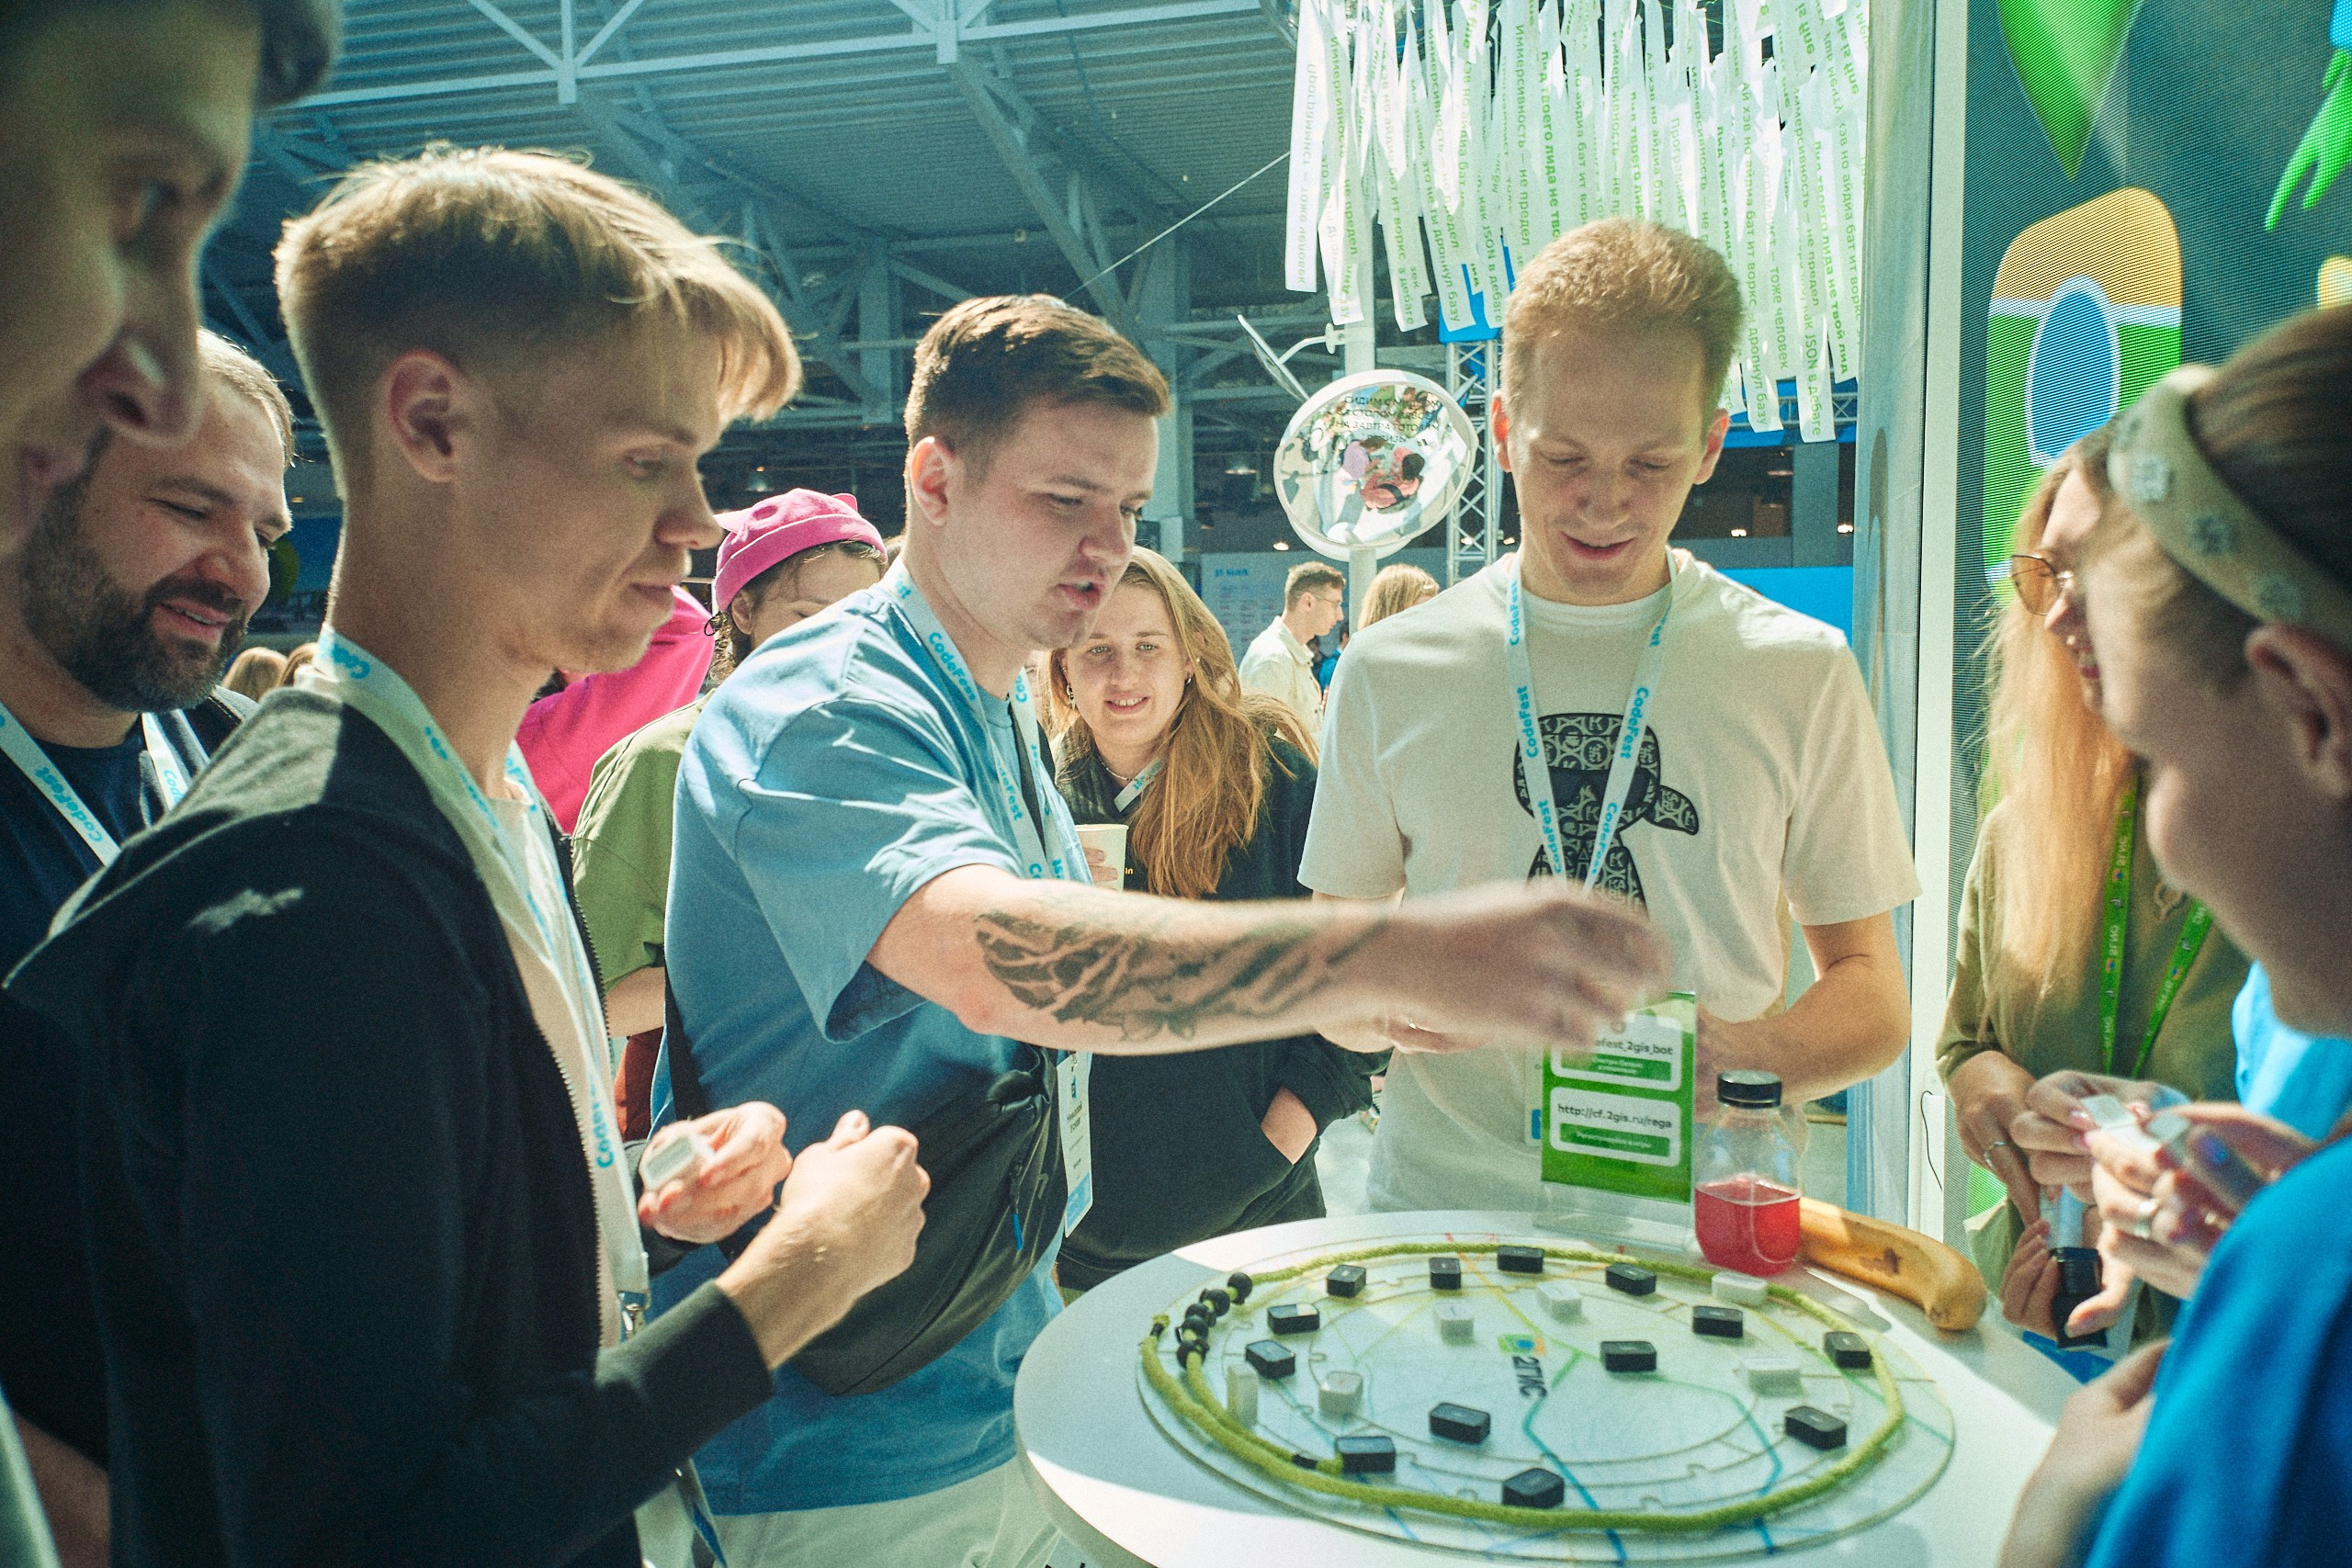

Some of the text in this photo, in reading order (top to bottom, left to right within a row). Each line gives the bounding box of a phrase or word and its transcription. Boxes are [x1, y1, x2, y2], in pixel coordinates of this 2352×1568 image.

[1515, 24, 1527, 149] Иммерсивность
[1647, 75, 1657, 102] хэв
[1540, 86, 1555, 141] твоего
[1575, 92, 1585, 138] айдиа
[1650, 105, 1658, 125] но
[1544, 144, 1558, 185] лида
[1577, 141, 1589, 168] бат
[1652, 129, 1663, 175] айдиа
[1690, 66, 1710, 230] Иммерсивность не
[1840, 150, 1850, 169] но
[1458, 161, 1470, 186] бат
[1520, 169, 1529, 187] не
[1579, 172, 1587, 190] ит
[1611, 177, 1620, 196] не
[1653, 178, 1665, 205] бат
[1716, 126, 1736, 260] Лид твоего лида
[1741, 82, 1758, 306] Ай хэв но айдиа бат ит воркс
[1391, 196, 1400, 212] ит
[1548, 188, 1559, 208] не
[1842, 174, 1855, 220] айдиа
[1342, 200, 1359, 255] предел
[1393, 217, 1407, 260] воркс
[1519, 191, 1532, 246] предел
[1806, 228, 1816, 248] не
[1845, 224, 1858, 250] бат
[1426, 186, 1435, 204] не
[1433, 228, 1453, 288] дропнул
[1446, 290, 1461, 322] базу
[1483, 224, 1498, 260] JSON
[1821, 235, 1835, 276] лида
[1805, 251, 1820, 306] предел
[1848, 254, 1858, 272] ит
[1398, 276, 1416, 325] дебаге
[1770, 265, 1784, 304] тоже
[1826, 279, 1838, 299] не
[1774, 307, 1790, 369] человек
[1830, 300, 1846, 340] твой
[1804, 333, 1819, 370] JSON
[1838, 343, 1849, 374] лид
[1747, 327, 1765, 389] дропнул
[1756, 392, 1769, 425] базу
[1808, 374, 1816, 382] в
[1806, 387, 1823, 435] дебаге
[928, 632, 977, 703] CodeFest
[1516, 685, 1539, 758] CodeFest
[1620, 687, 1649, 760] CodeFest
[35, 766, 103, 843] CodeFest
[1538, 799, 1562, 874] CodeFest
[1591, 802, 1617, 874] CodeFest
[1595, 1038, 1674, 1055] efest_2gis_bot
[1557, 1103, 1673, 1130] http://cf.2gis.ru/rega
[1512, 1356, 1547, 1397] 2ГИС
